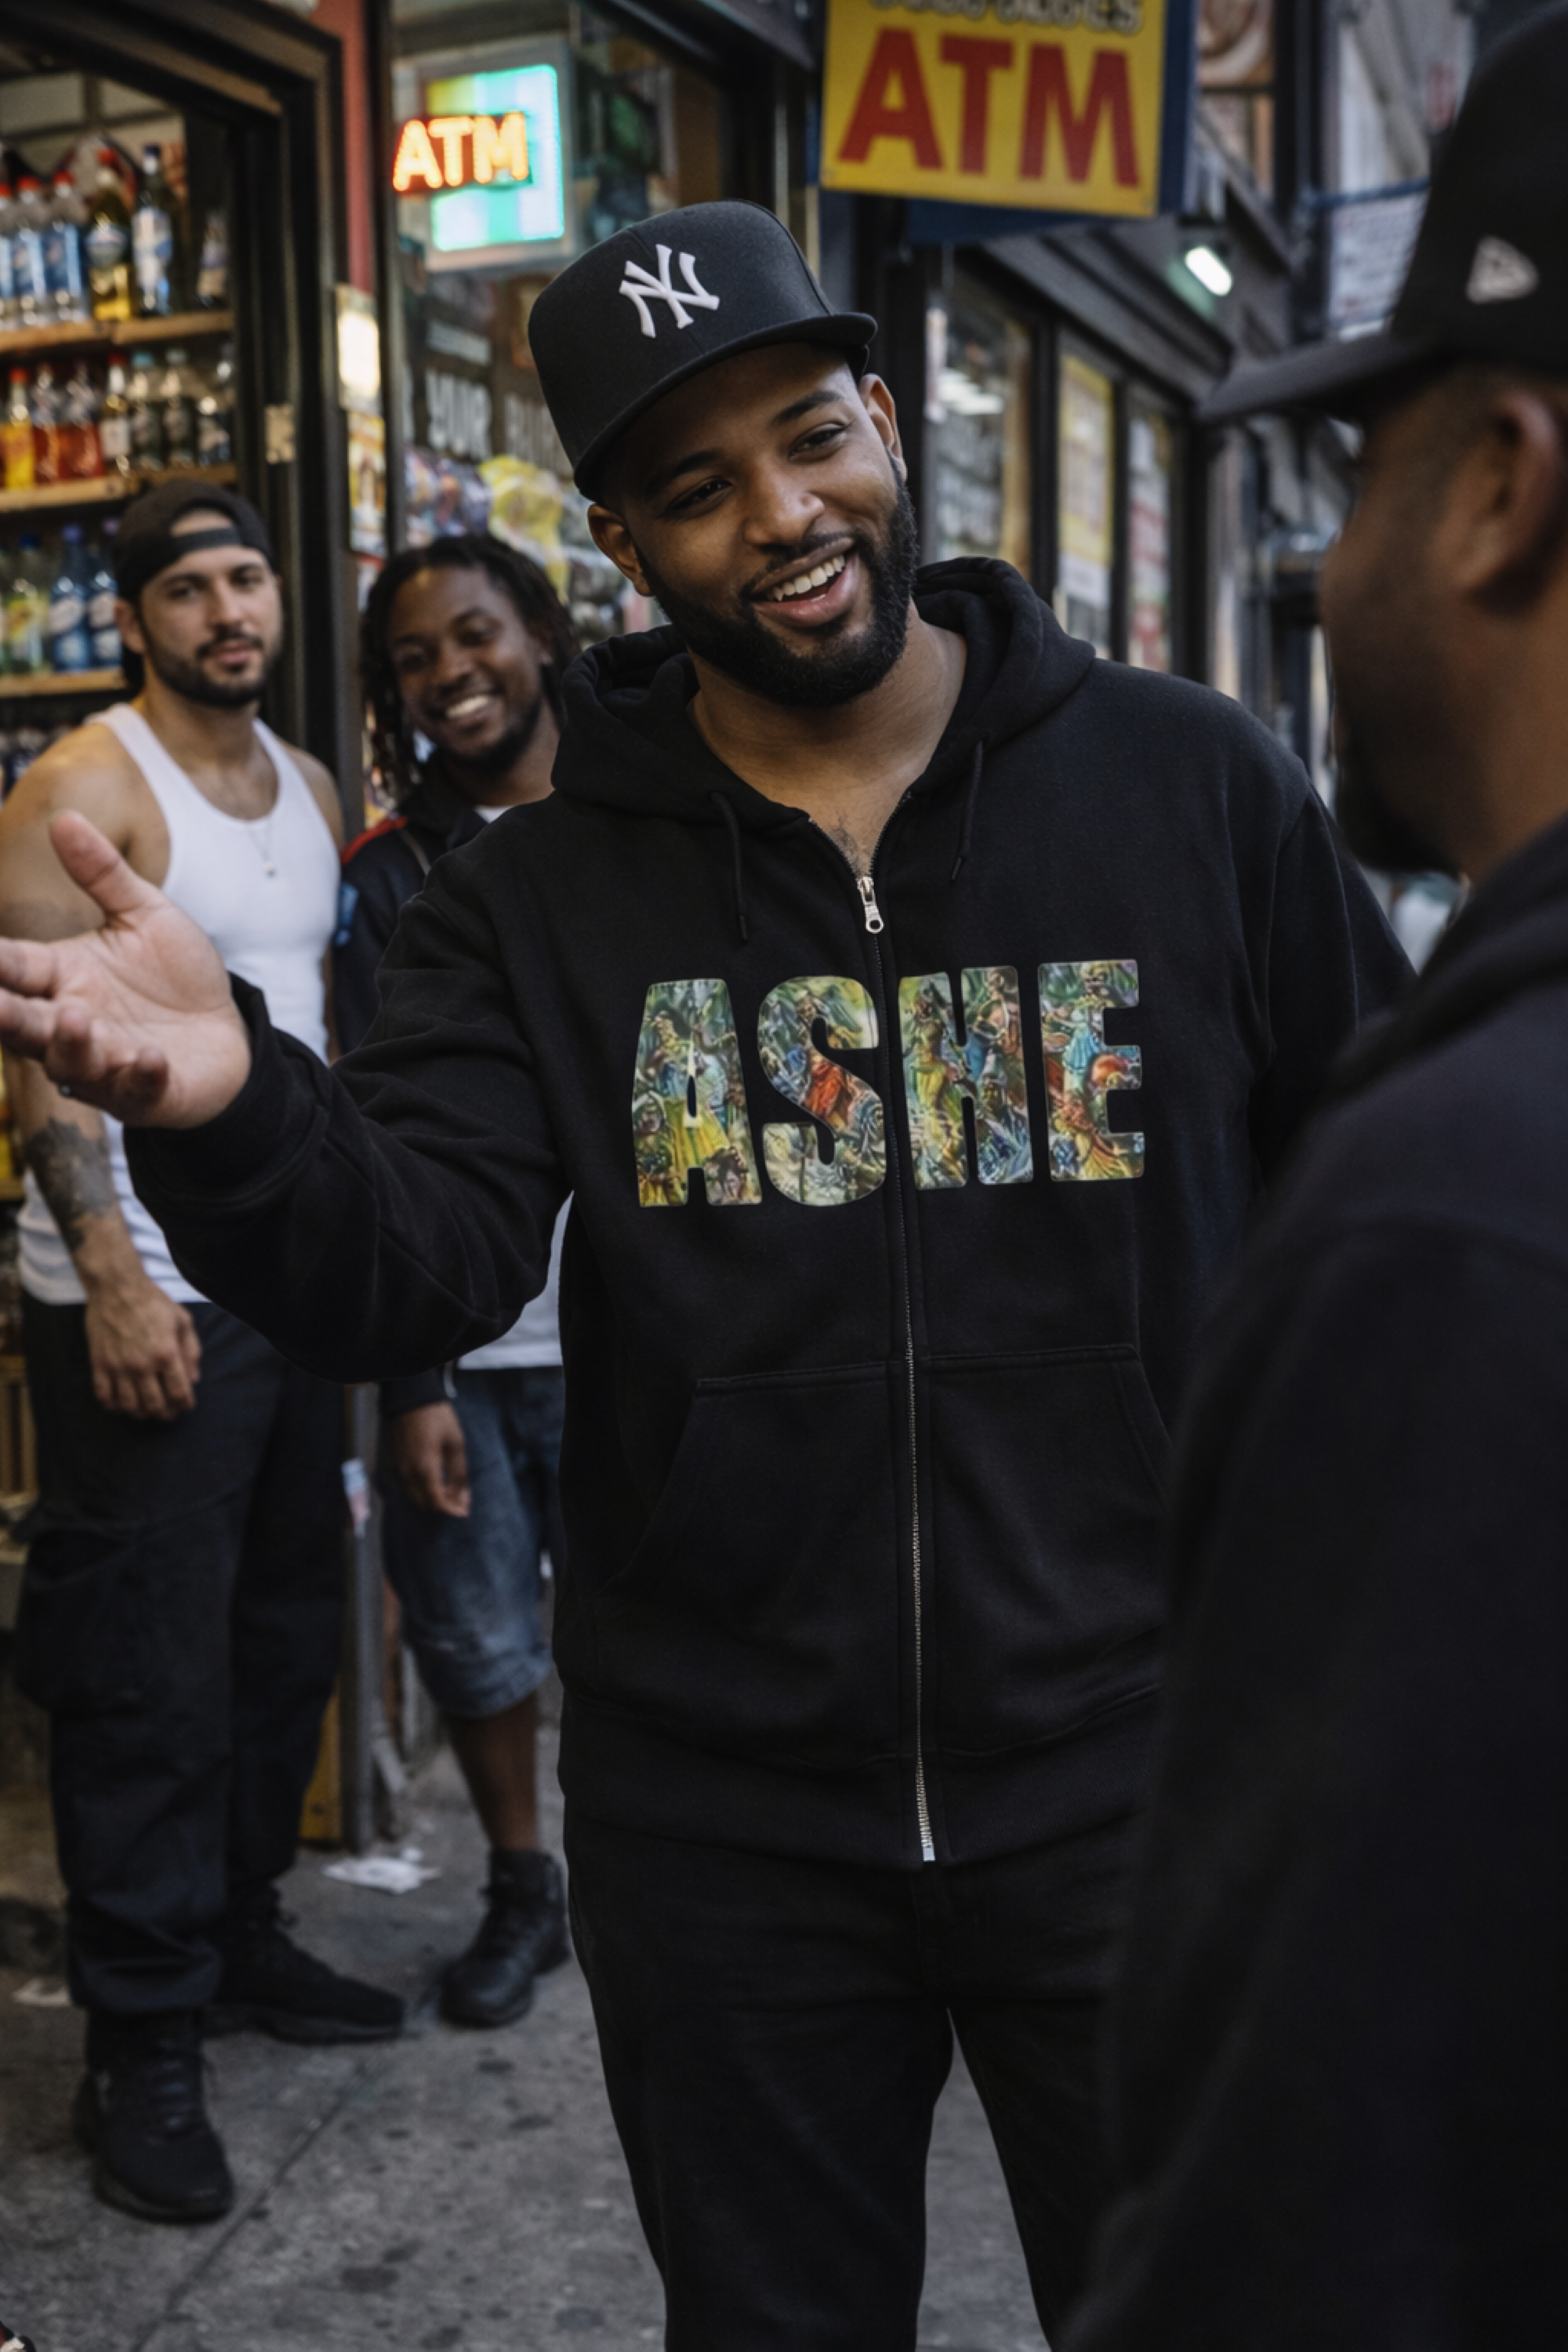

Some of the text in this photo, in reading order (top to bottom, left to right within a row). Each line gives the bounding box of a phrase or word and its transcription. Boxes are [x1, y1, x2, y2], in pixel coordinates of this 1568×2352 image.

[393, 111, 529, 191] ATM
[837, 27, 1139, 188] ATM
[619, 243, 720, 339] NY
[631, 959, 1145, 1207] ASHE
